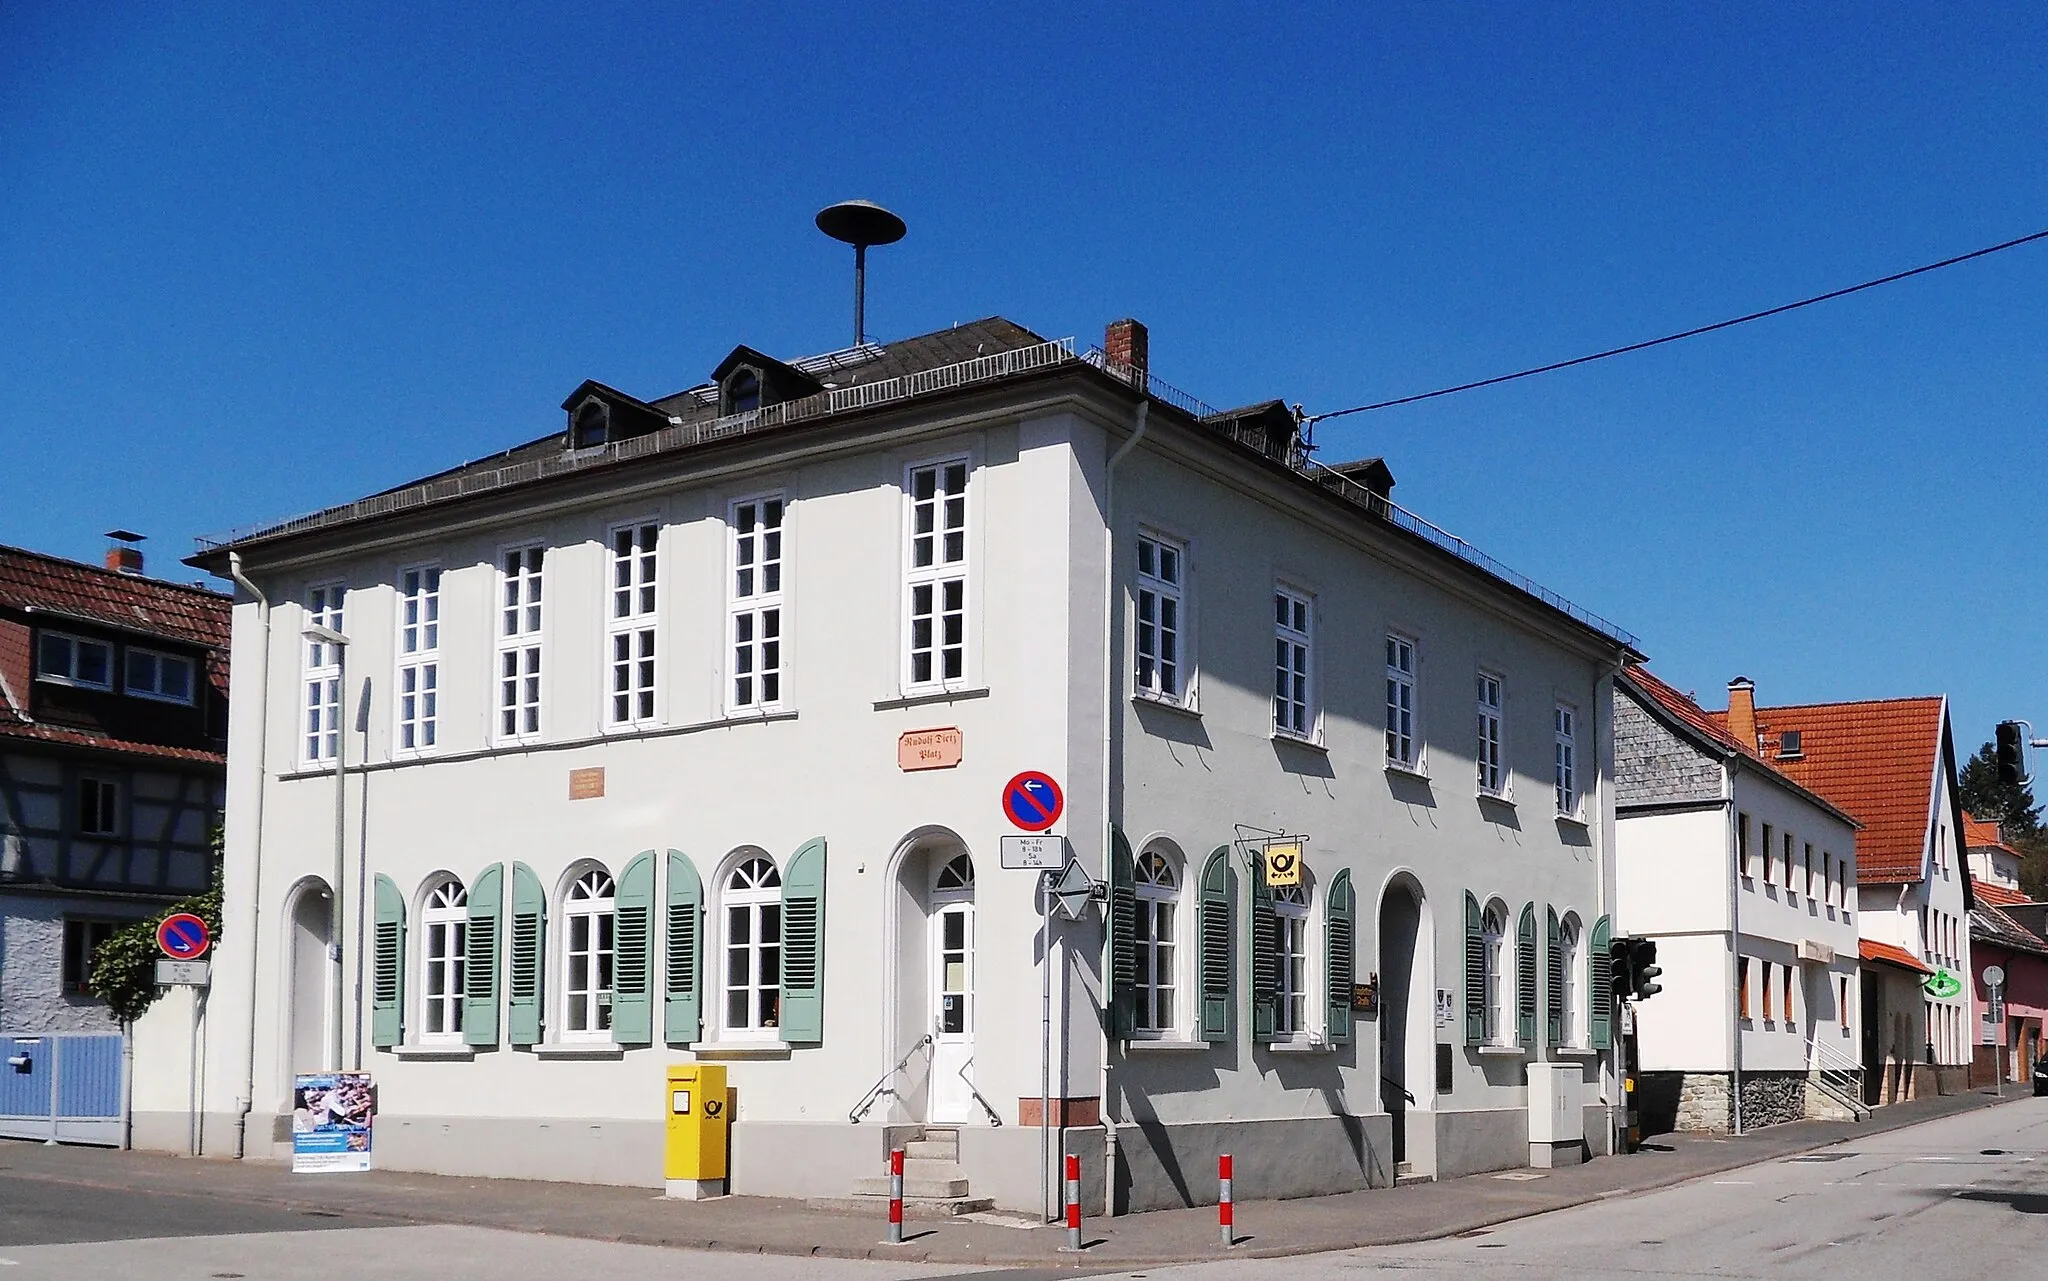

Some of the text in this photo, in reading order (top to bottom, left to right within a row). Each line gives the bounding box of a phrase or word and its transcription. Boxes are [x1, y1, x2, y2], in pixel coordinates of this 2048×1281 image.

[904, 734, 957, 746] Rudolf Dietz
[919, 749, 942, 760] Platz
